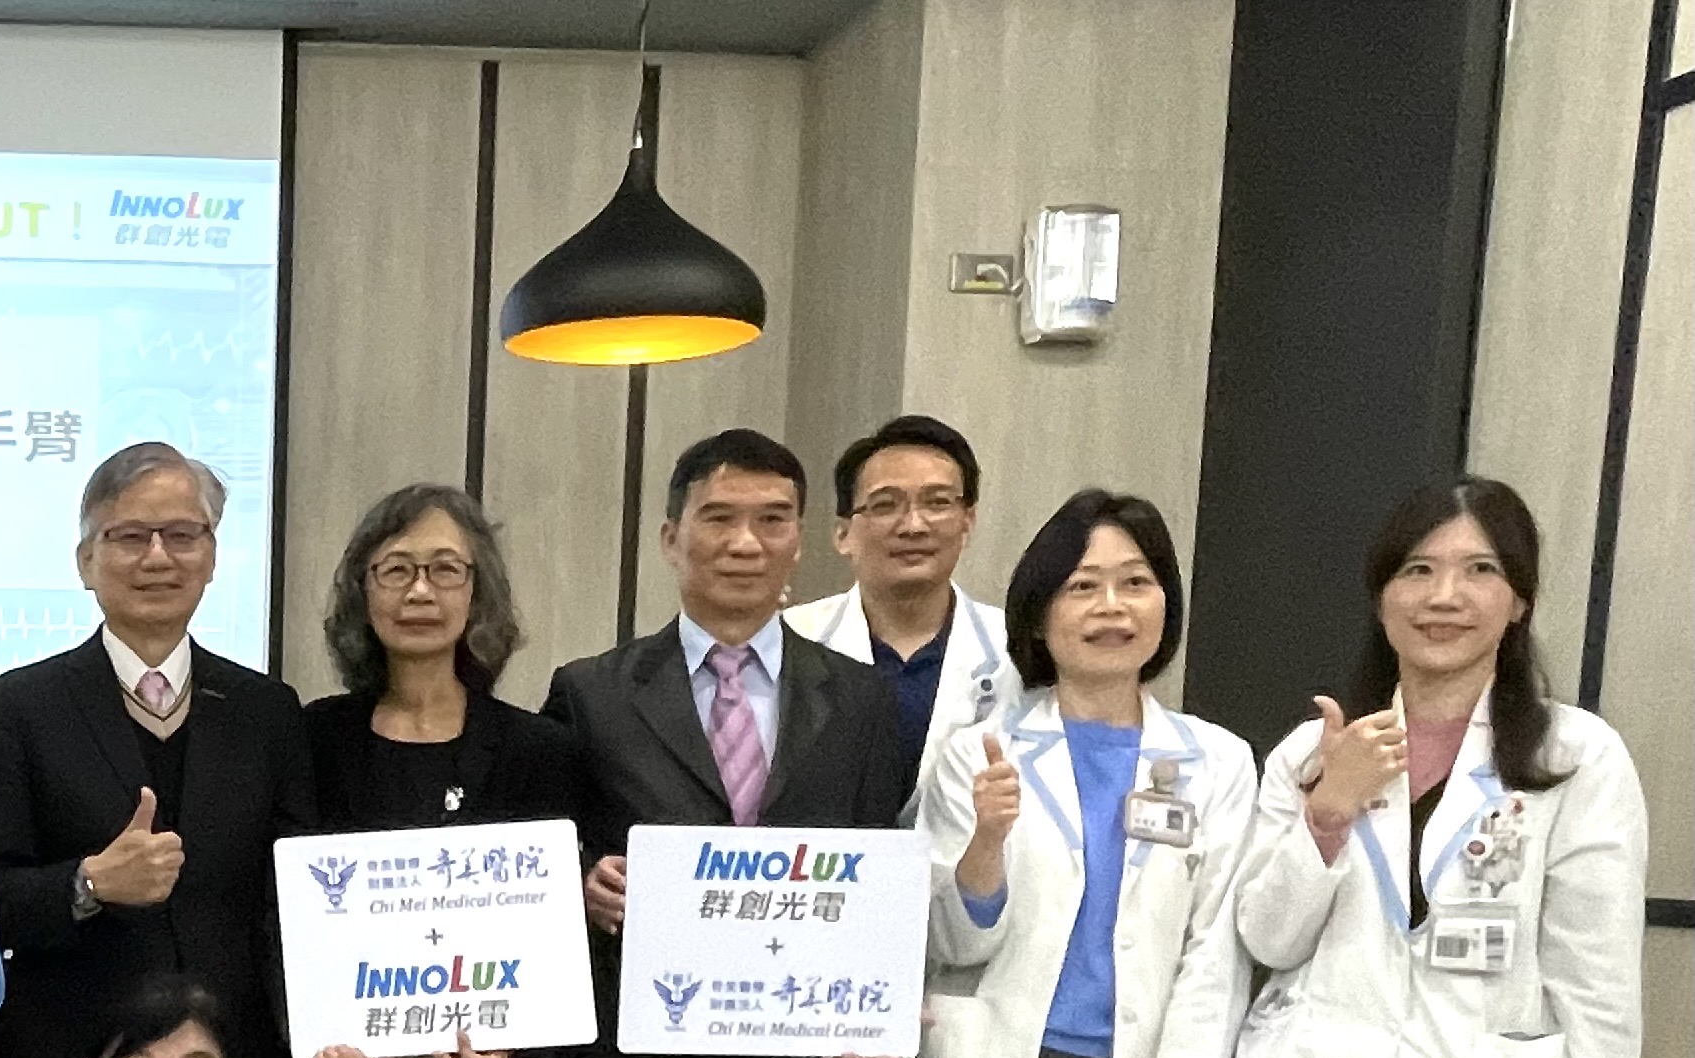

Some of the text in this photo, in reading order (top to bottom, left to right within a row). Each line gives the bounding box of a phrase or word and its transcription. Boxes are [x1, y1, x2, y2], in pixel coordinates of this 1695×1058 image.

[369, 890, 547, 914] Chi Mei Medical Center
[699, 889, 846, 922] 群創光電
[365, 999, 510, 1037] 群創光電
[708, 1021, 886, 1039] Chi Mei Medical Center
